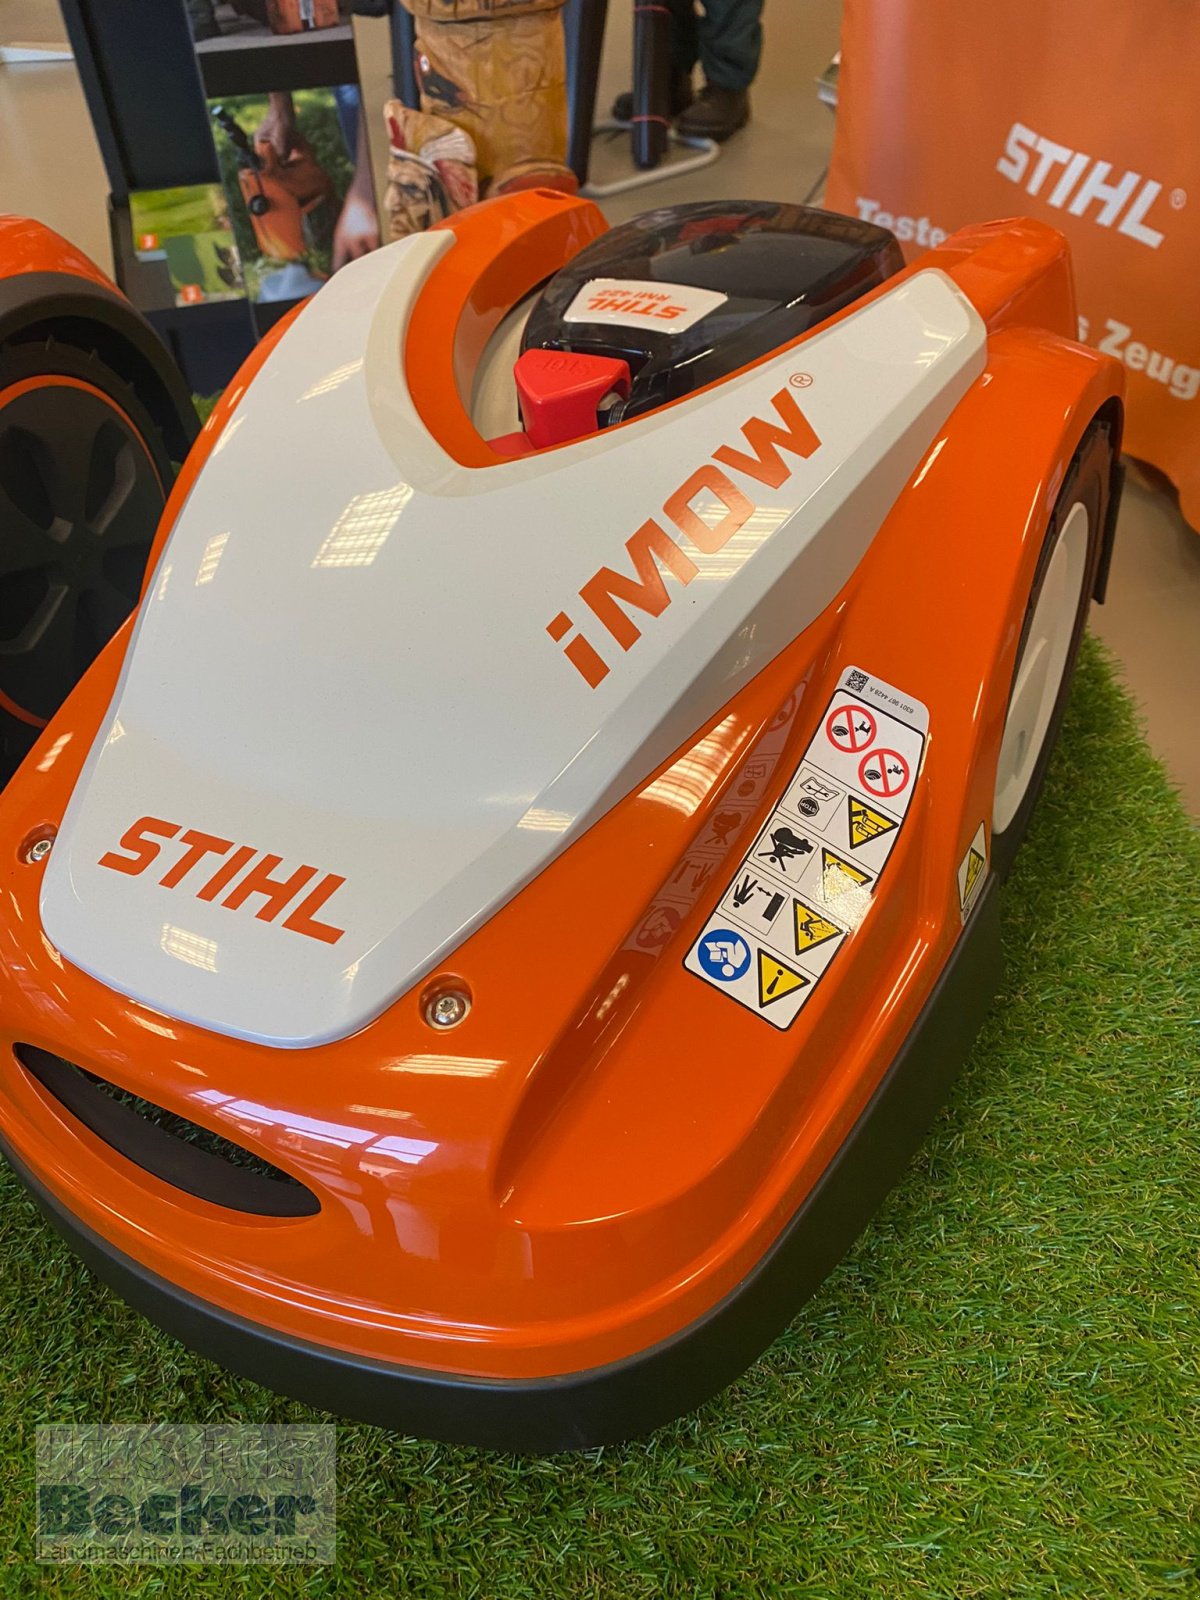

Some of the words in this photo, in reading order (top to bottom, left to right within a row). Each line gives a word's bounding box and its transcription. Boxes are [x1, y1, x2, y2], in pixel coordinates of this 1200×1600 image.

[597, 289, 632, 297] 422
[633, 290, 672, 301] RMI
[587, 298, 688, 320] STIHL
[1099, 318, 1200, 400] Zeug
[97, 816, 347, 945] STIHL
